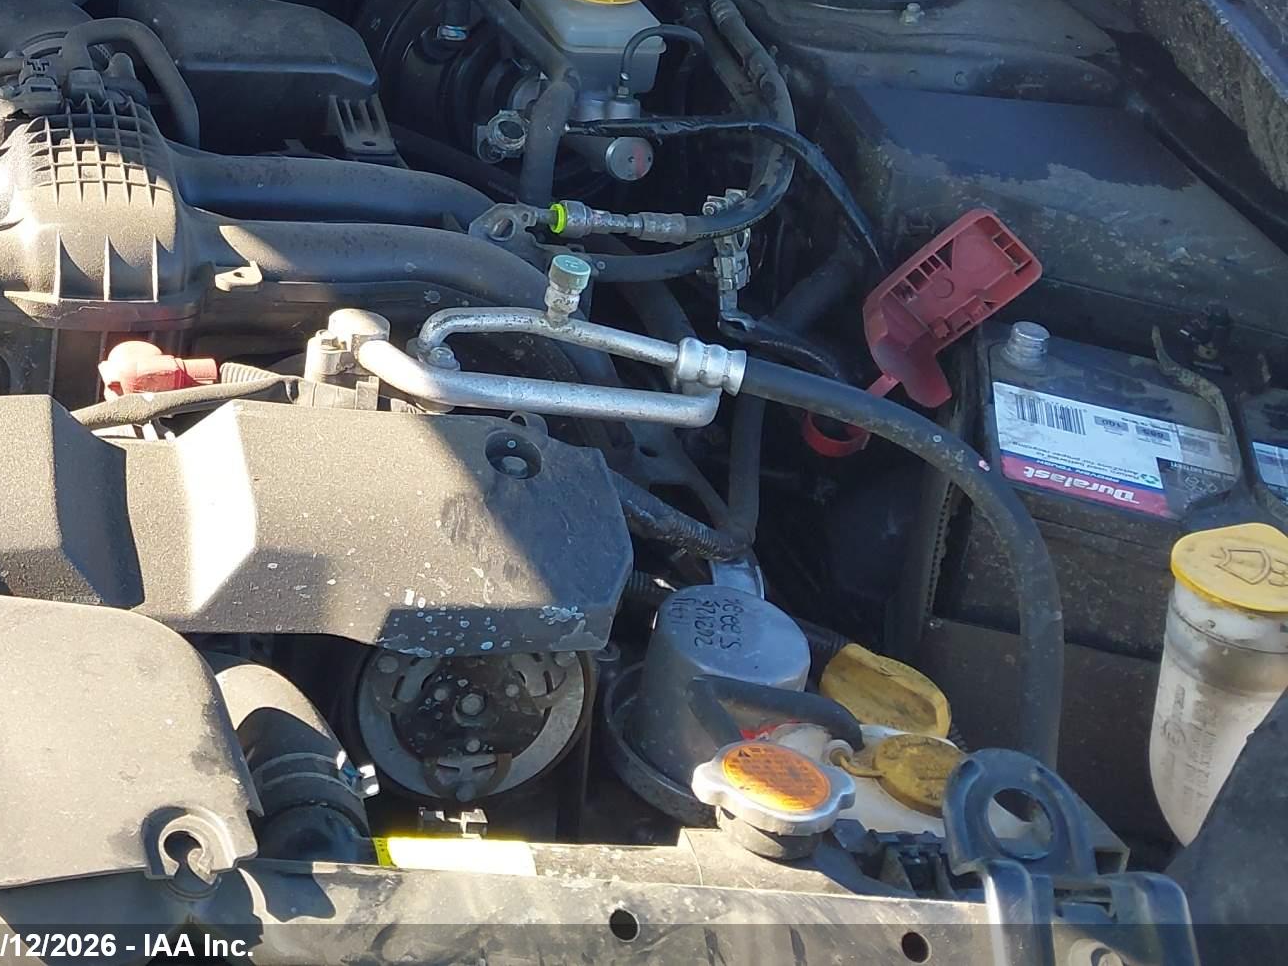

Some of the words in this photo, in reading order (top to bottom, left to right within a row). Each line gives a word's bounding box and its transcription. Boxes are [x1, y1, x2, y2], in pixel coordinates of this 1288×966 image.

[1036, 459, 1072, 472] TOUGH
[1075, 469, 1120, 483] PROVEN
[1024, 466, 1140, 504] Duralast
